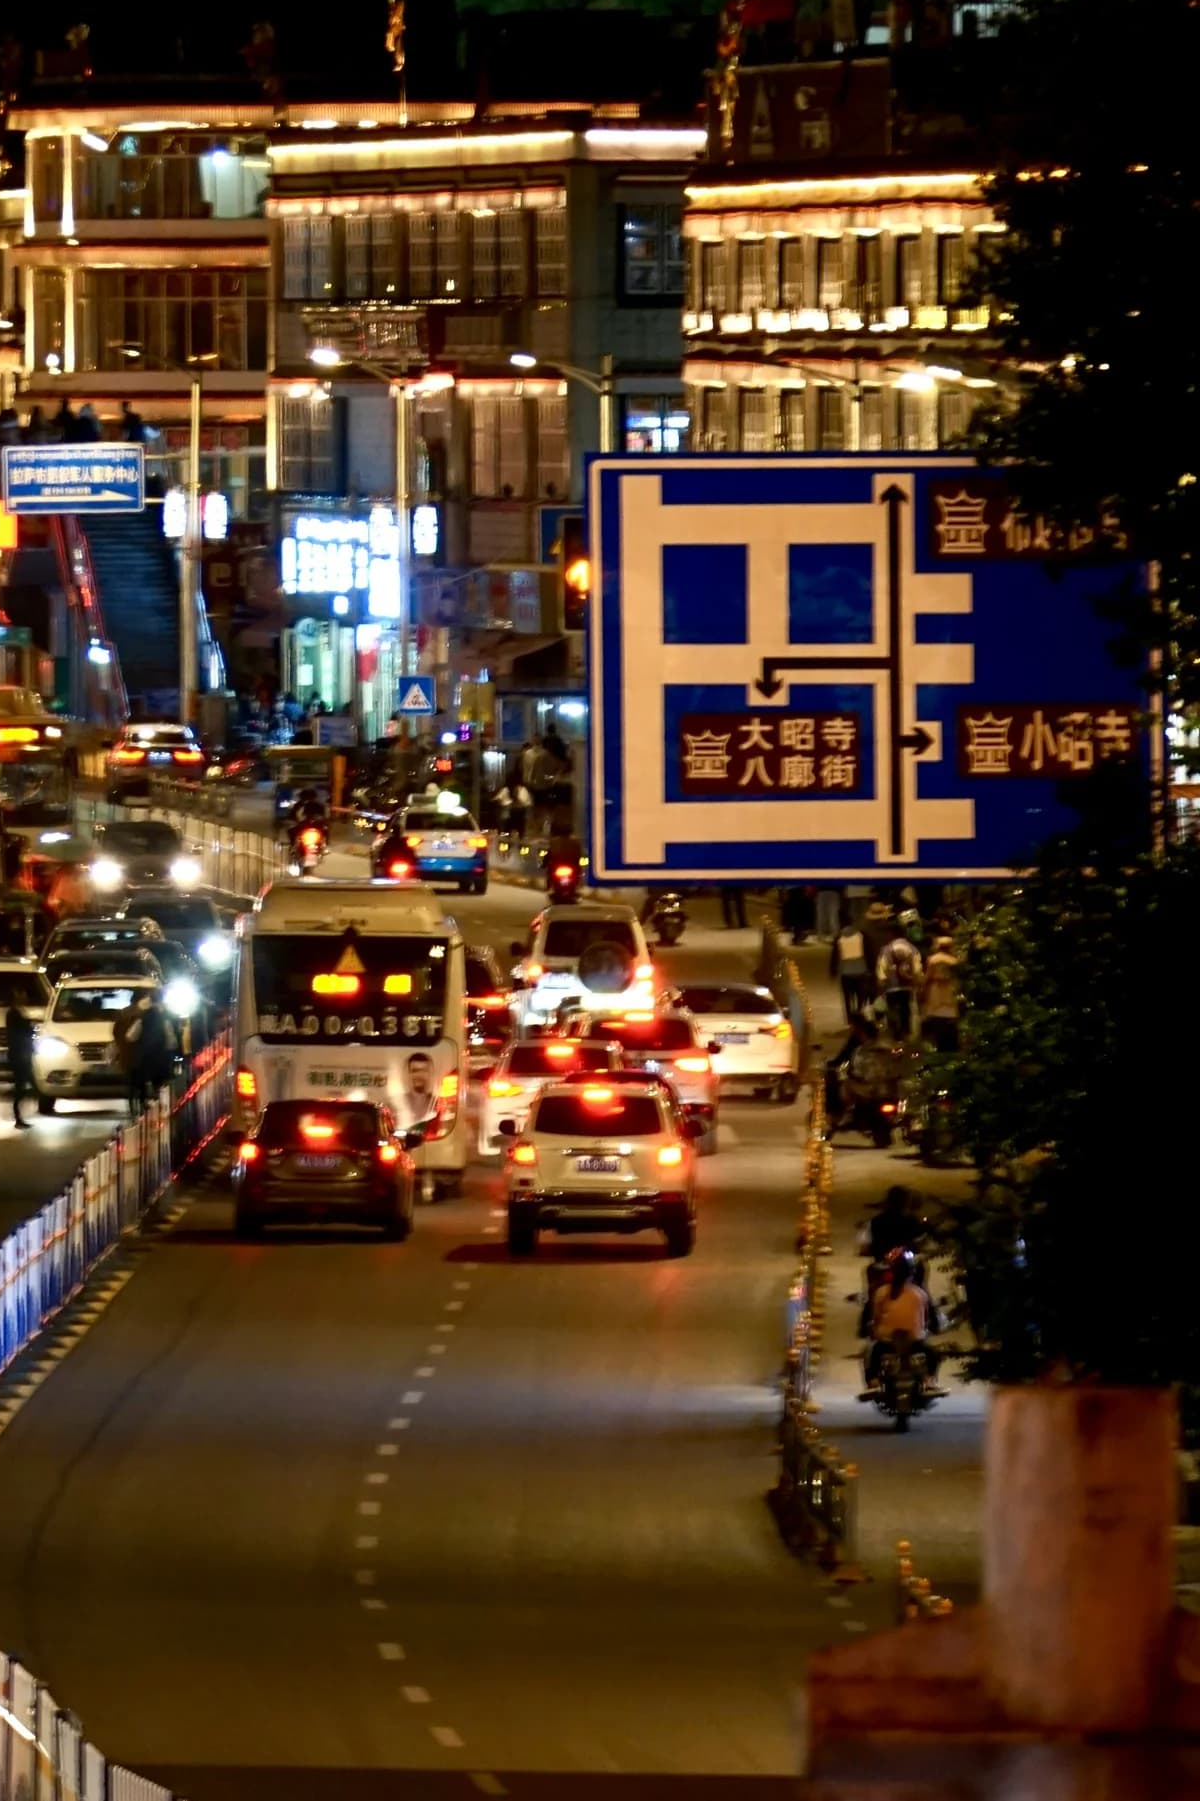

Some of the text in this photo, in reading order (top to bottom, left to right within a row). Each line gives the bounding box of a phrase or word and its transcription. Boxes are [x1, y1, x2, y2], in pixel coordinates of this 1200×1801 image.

[738, 717, 856, 750] 大昭寺
[1019, 709, 1131, 771] 小昭寺
[738, 755, 857, 788] 八廓街
